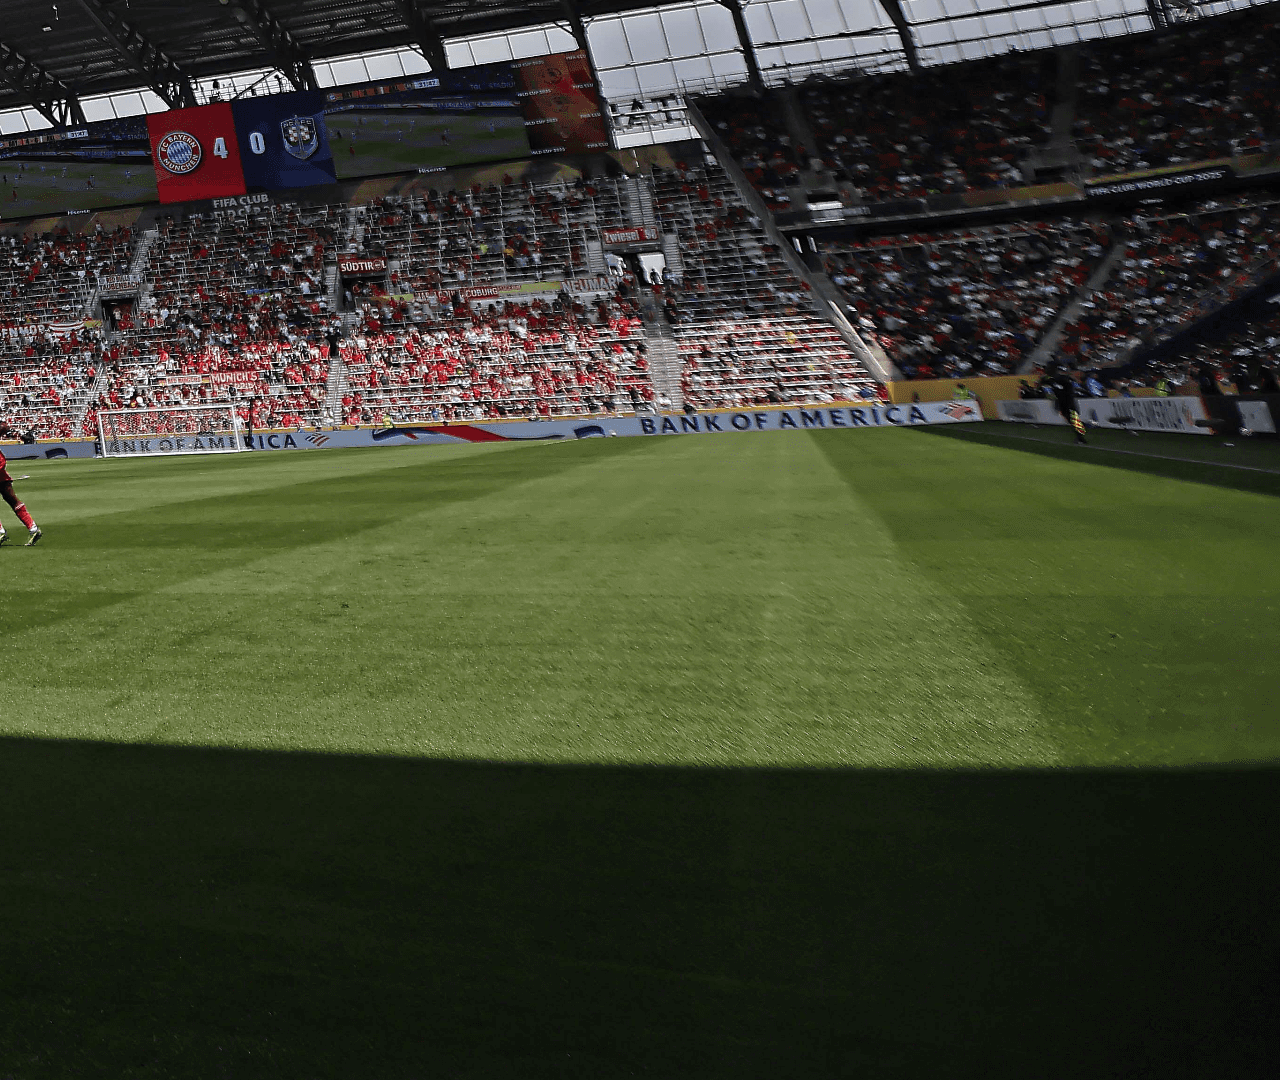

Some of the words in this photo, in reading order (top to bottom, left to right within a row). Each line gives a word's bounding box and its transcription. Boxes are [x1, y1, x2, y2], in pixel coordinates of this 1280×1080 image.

[167, 134, 197, 148] BAYERN
[213, 137, 229, 159] 4
[249, 132, 266, 155] 0
[213, 198, 237, 209] FIFA
[240, 194, 269, 205] CLUB
[466, 287, 498, 297] COBURG
[561, 277, 621, 294] NEUMAR
[641, 414, 723, 435] BANK
[731, 413, 768, 431] OF
[780, 405, 929, 430] AMERICA
[159, 437, 186, 451] OF
